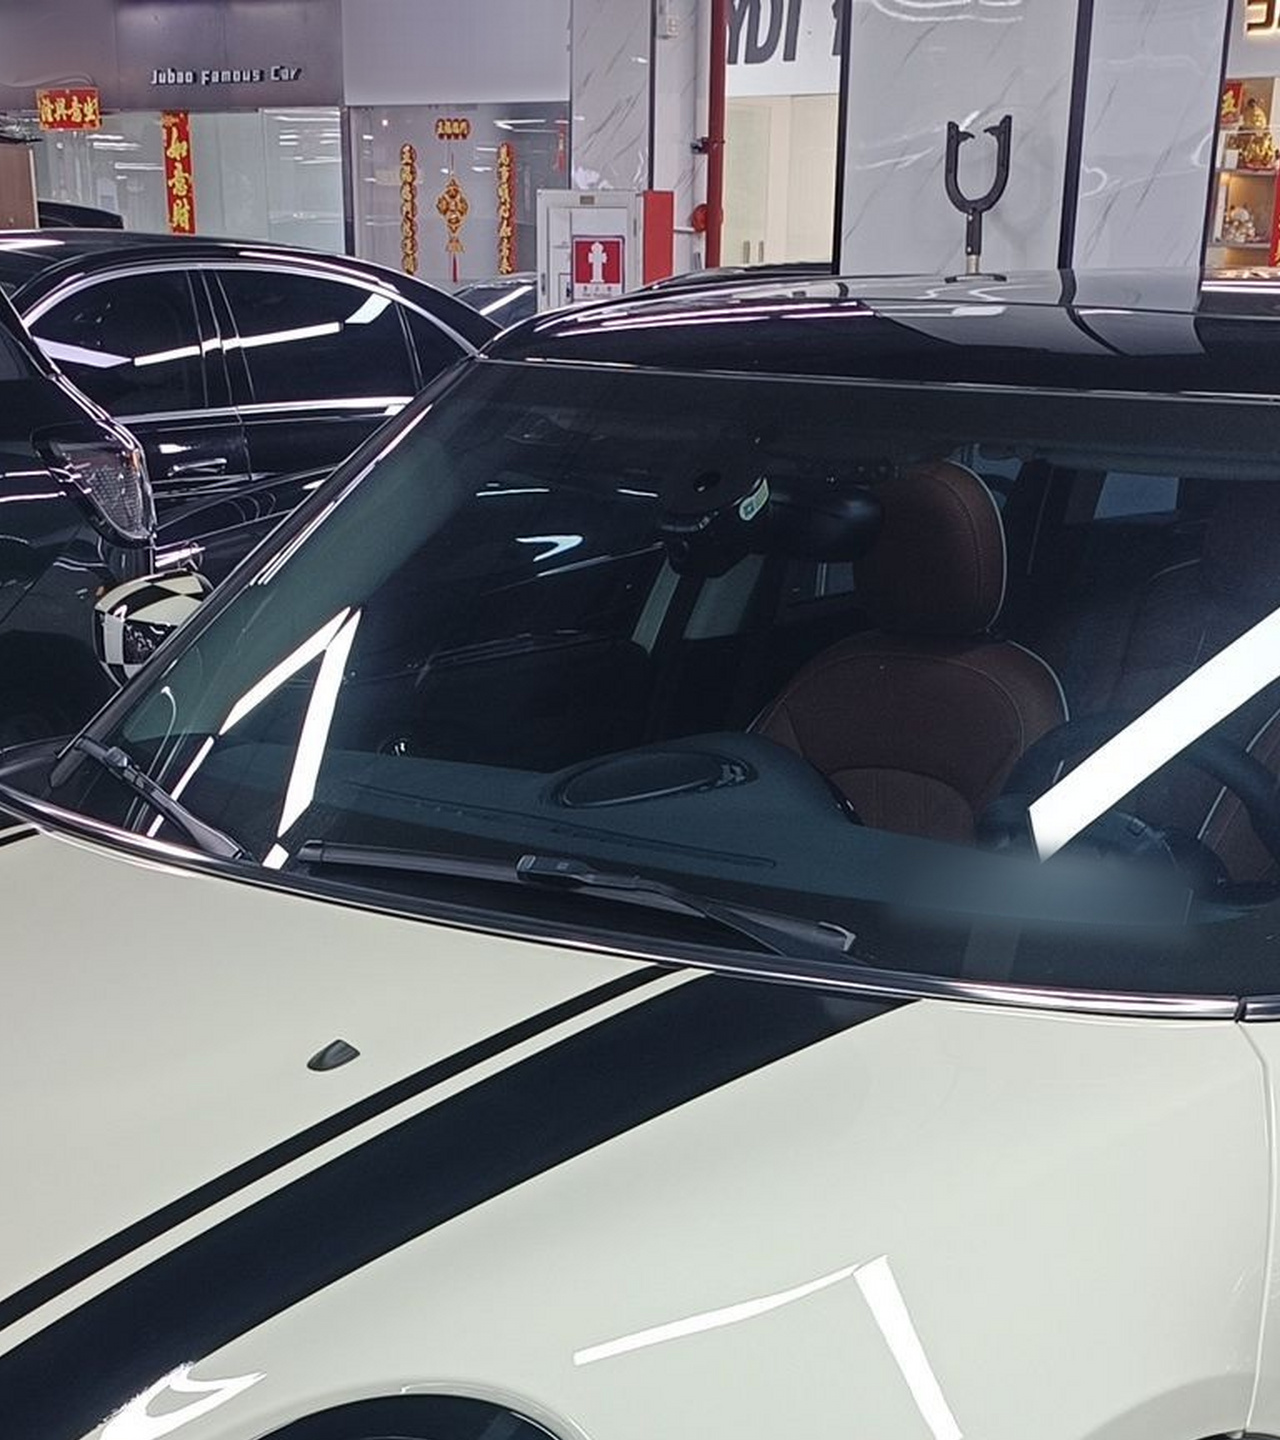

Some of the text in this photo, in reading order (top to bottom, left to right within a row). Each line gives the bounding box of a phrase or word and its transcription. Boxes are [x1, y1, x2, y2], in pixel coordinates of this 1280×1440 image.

[151, 65, 299, 86] Jubao Famous Car
